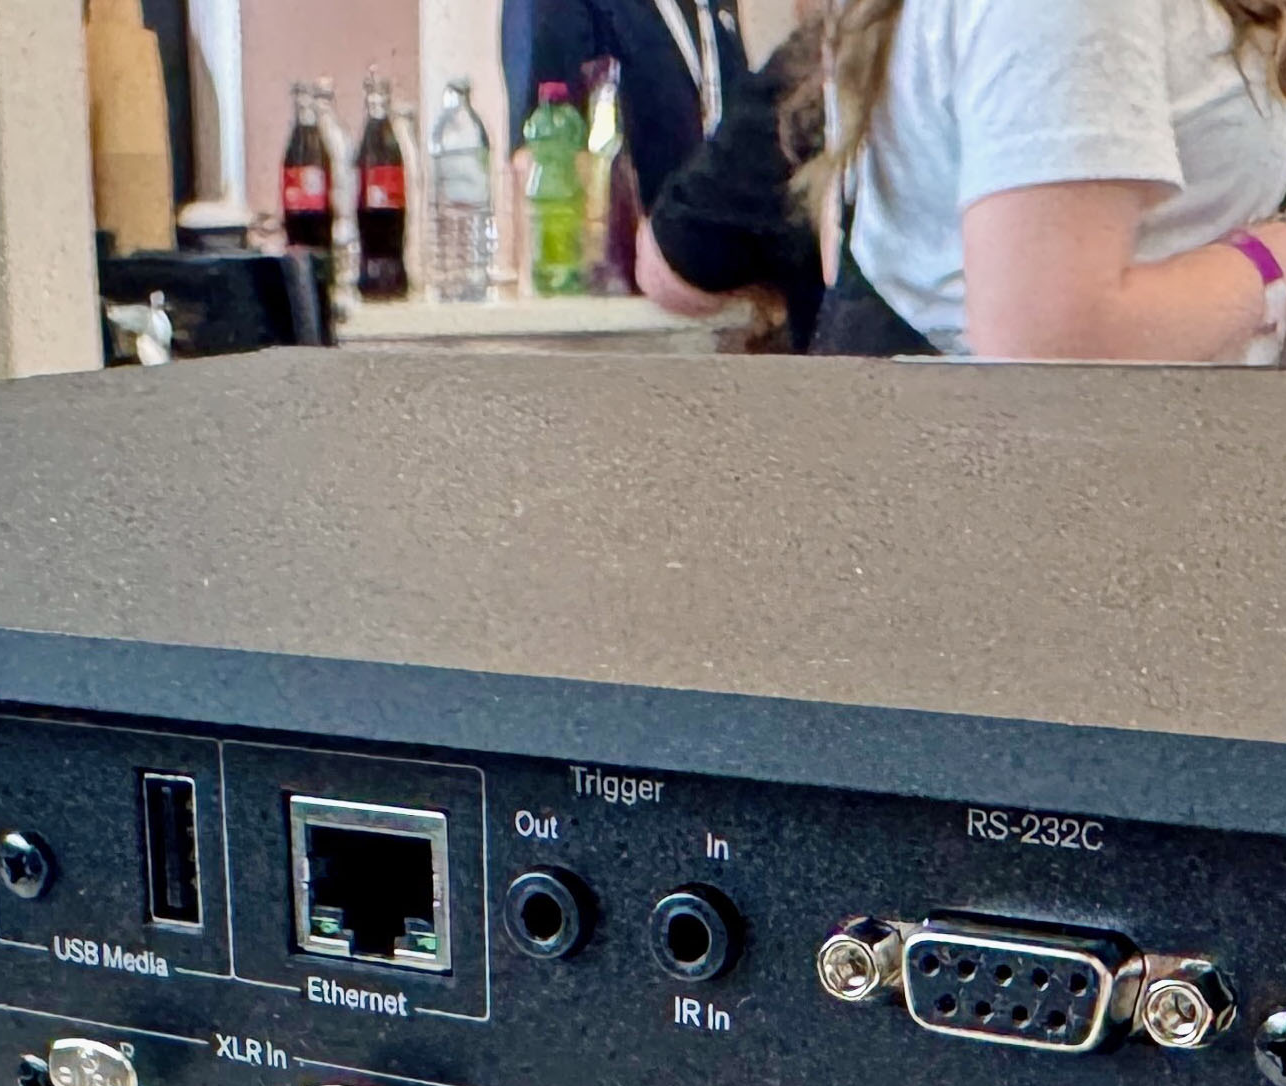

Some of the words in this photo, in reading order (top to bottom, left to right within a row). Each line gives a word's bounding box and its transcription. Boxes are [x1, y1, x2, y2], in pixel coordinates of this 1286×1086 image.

[569, 765, 664, 806] Trigger
[515, 809, 559, 839] Out
[967, 808, 1104, 852] RS-232C
[707, 832, 729, 861] In
[54, 936, 99, 965] USB
[103, 942, 169, 977] Media
[307, 976, 408, 1016] Ethernet
[674, 996, 701, 1028] IR
[707, 1002, 731, 1031] In
[216, 1033, 263, 1066] XLR
[266, 1041, 288, 1070] In
